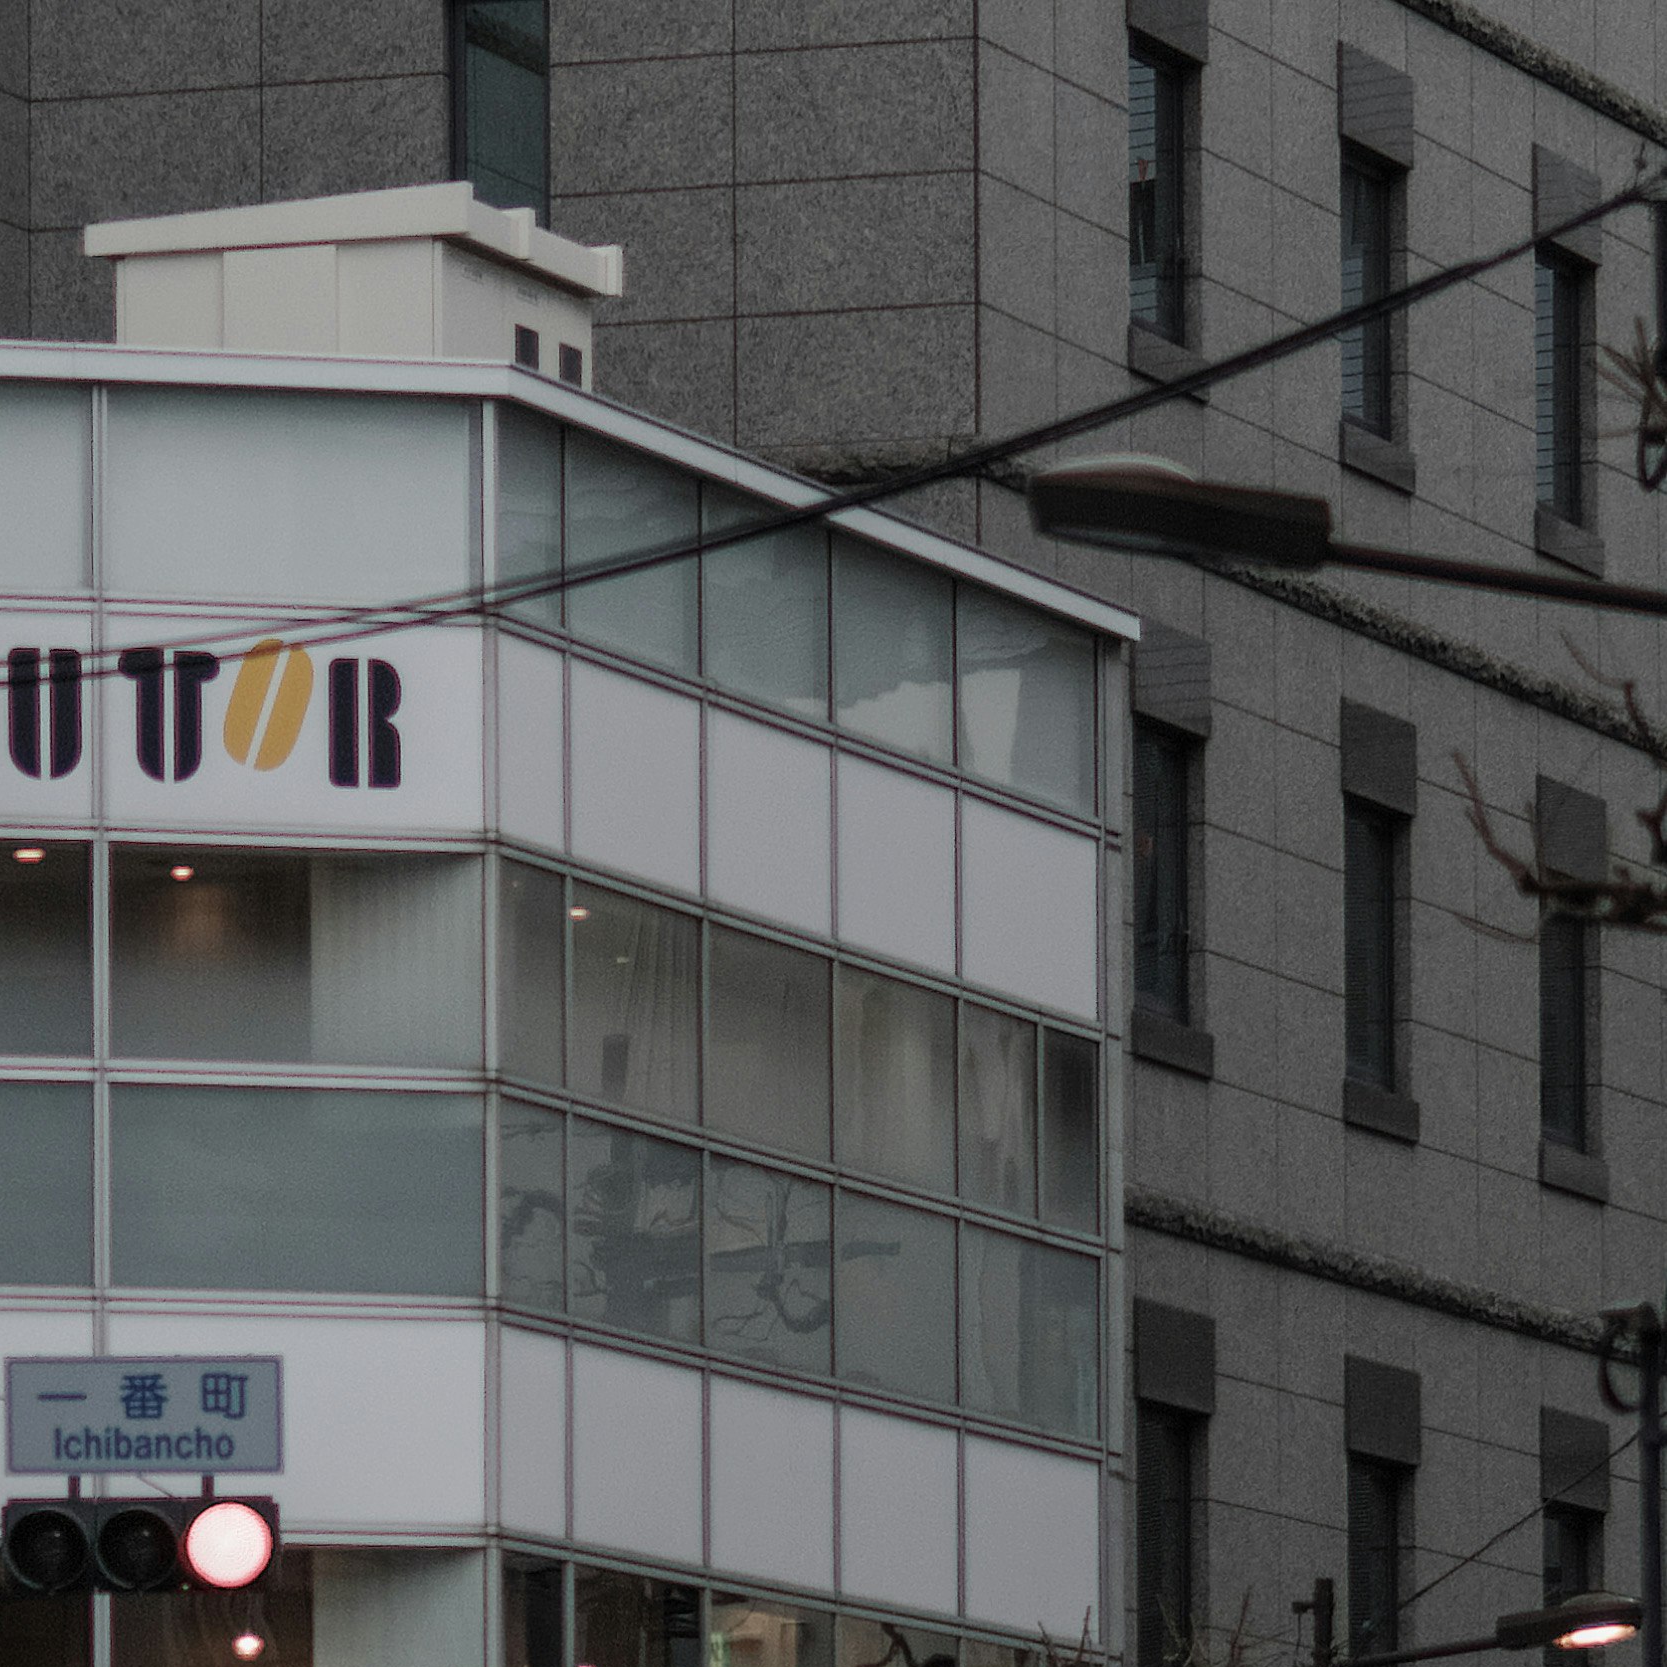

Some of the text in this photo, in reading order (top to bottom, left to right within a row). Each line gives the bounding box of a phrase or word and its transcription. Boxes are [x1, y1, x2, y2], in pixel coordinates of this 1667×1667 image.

[38, 1372, 248, 1419] 一番町
[54, 1427, 235, 1461] Ichibancho
